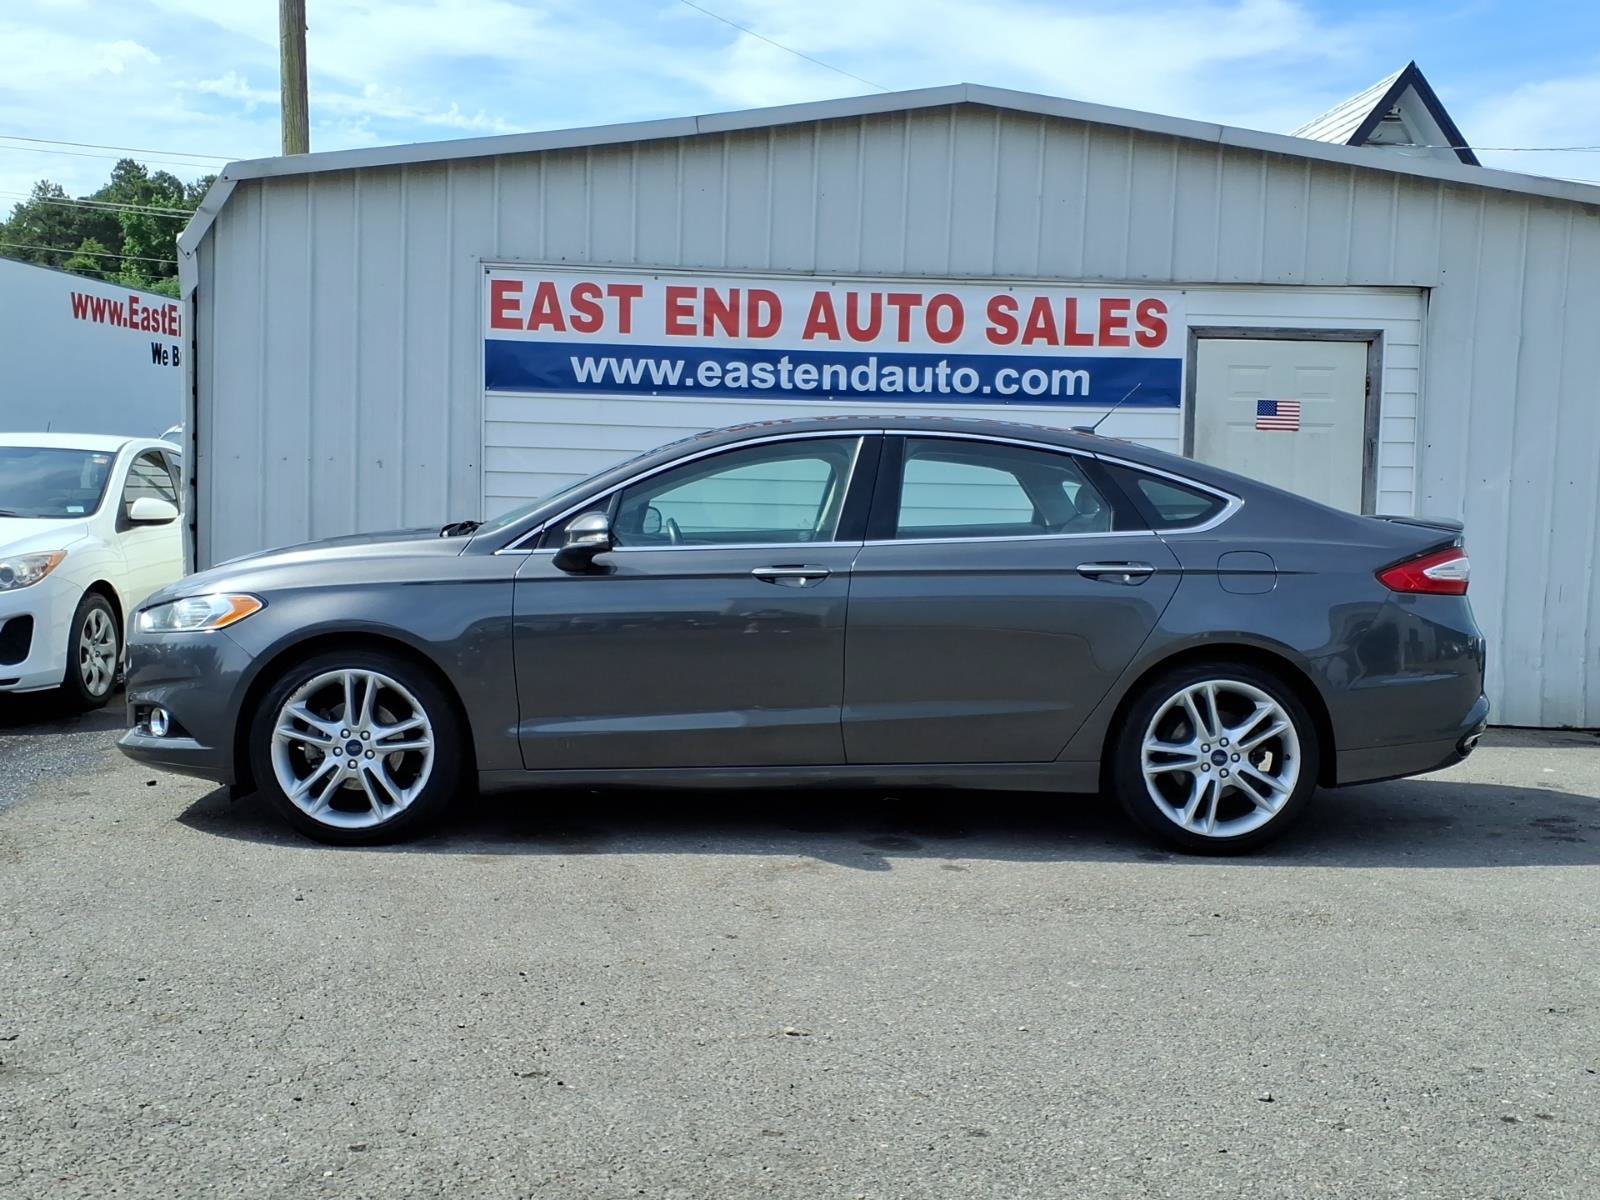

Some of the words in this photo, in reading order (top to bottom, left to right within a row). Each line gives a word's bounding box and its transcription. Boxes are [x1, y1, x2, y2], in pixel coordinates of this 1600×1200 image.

[490, 280, 643, 334] EAST
[665, 286, 782, 339] END
[802, 291, 965, 345] AUTO
[985, 294, 1168, 348] SALES
[151, 342, 168, 366] We
[172, 345, 182, 367] B
[571, 355, 1090, 396] www.eastendauto.com
